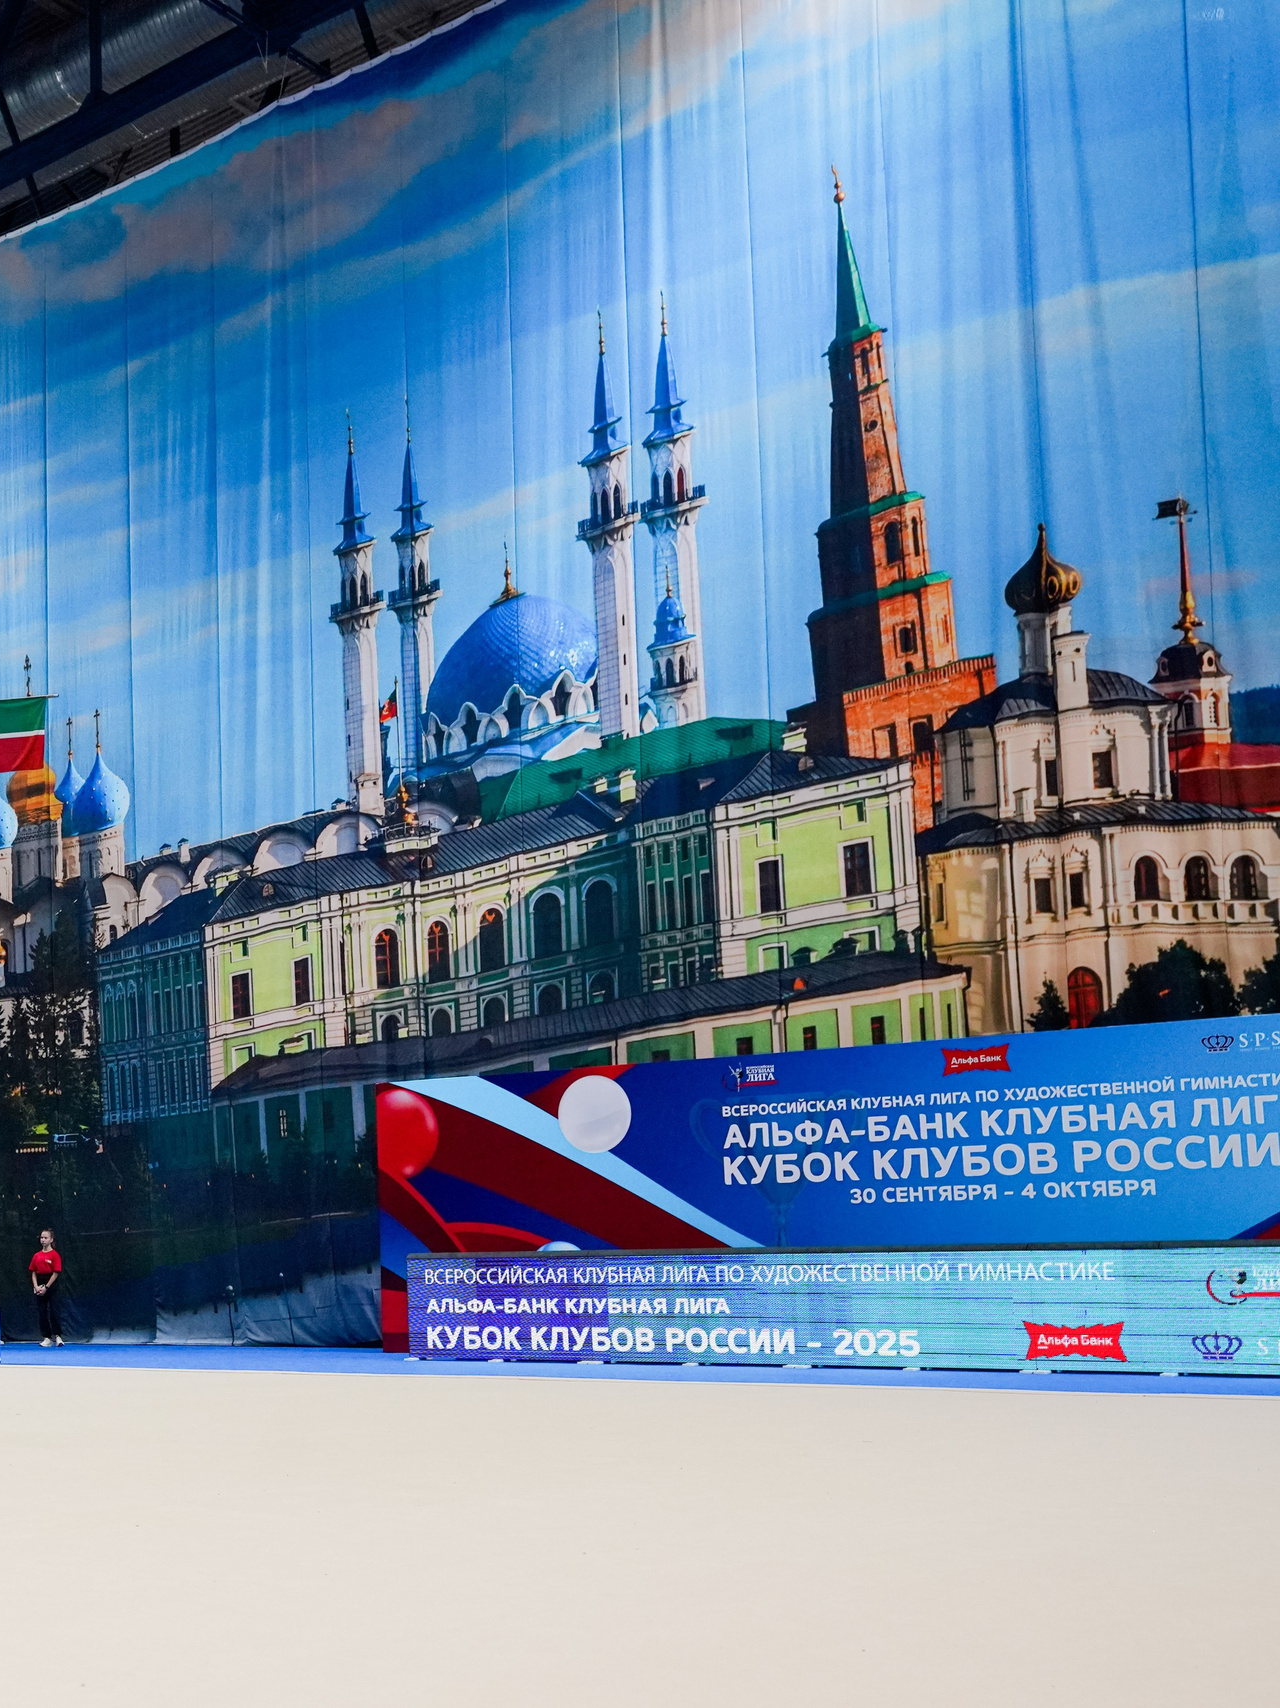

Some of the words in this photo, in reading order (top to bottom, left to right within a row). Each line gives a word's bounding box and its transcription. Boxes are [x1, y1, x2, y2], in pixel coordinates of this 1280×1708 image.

[950, 1056, 979, 1066] Альфа
[979, 1054, 1002, 1064] Банк
[746, 1073, 775, 1082] ЛИГА
[722, 1098, 847, 1118] ВСЕРОССИЙСКАЯ
[851, 1094, 925, 1110] КЛУБНАЯ
[929, 1091, 971, 1106] ЛИГА
[975, 1089, 999, 1103] ПО
[1004, 1076, 1175, 1102] ХУДОЖЕСТВЕННОЙ
[1180, 1073, 1280, 1091] ГИМНАСТИ
[723, 1110, 969, 1149] АЛЬФА-БАНК
[981, 1100, 1176, 1137] КЛУБНАЯ
[1190, 1094, 1279, 1127] ЛИГ
[723, 1150, 860, 1186] КУБОК
[872, 1142, 1058, 1180] КЛУБОВ
[1072, 1132, 1280, 1173] РОССИИ
[849, 1188, 877, 1204] 30
[882, 1184, 997, 1203] СЕНТЯБРЯ
[1021, 1182, 1036, 1198] 4
[1043, 1179, 1157, 1198] ОКТЯБРЯ
[425, 1265, 568, 1285] ВСЕРОССИЙСКАЯ
[573, 1267, 655, 1284] КЛУБНАЯ
[661, 1265, 710, 1283] ЛИГА
[715, 1265, 744, 1283] ПО
[750, 1260, 950, 1286] ХУДОЖЕСТВЕННОЙ
[957, 1261, 1116, 1281] ГИМНАСТИКЕ
[426, 1298, 558, 1314] АЛЬФА-БАНК
[565, 1298, 667, 1314] КЛУБНАЯ
[674, 1297, 731, 1315] ЛИГА
[426, 1326, 521, 1351] КУБОК
[531, 1327, 655, 1353] КЛУБОВ
[665, 1327, 796, 1355] РОССИИ
[832, 1329, 921, 1357] 2025
[1037, 1333, 1079, 1347] Альфа
[1080, 1334, 1113, 1346] Банк
